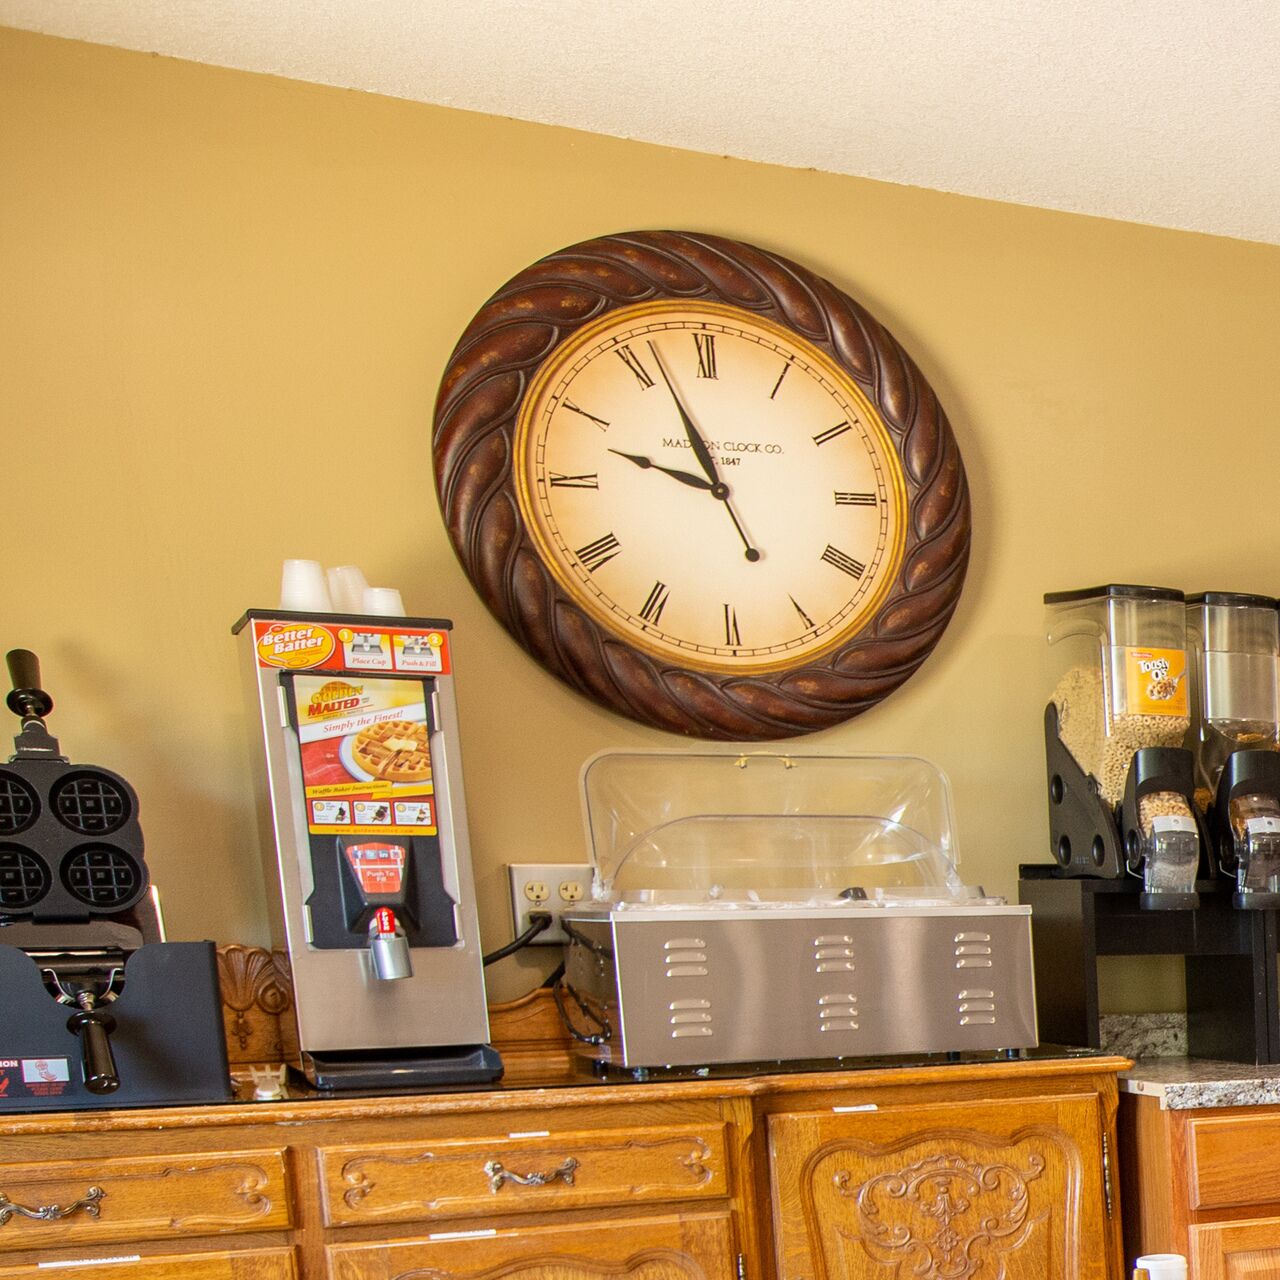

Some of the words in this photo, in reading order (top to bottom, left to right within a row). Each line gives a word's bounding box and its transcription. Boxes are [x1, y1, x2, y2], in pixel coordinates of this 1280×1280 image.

[693, 333, 718, 380] XII
[614, 344, 656, 391] XI
[770, 362, 791, 400] I
[562, 397, 610, 432] X
[812, 420, 853, 446] II
[662, 438, 720, 451] MADON
[723, 441, 762, 453] CLOCK
[765, 444, 785, 454] CO.
[721, 457, 741, 466] 1847
[549, 472, 599, 490] IX
[834, 490, 877, 507] III
[575, 532, 623, 573] VIII
[638, 580, 671, 627] VII
[723, 604, 742, 646] VI
[263, 627, 314, 646] Better
[274, 637, 325, 654] Batter
[352, 657, 371, 665] Place
[372, 658, 387, 666] Cup
[311, 685, 364, 704] GOLDEN
[308, 697, 361, 717] MALTED
[323, 721, 355, 733] Simply
[356, 715, 371, 726] the
[373, 710, 404, 723] Finest!
